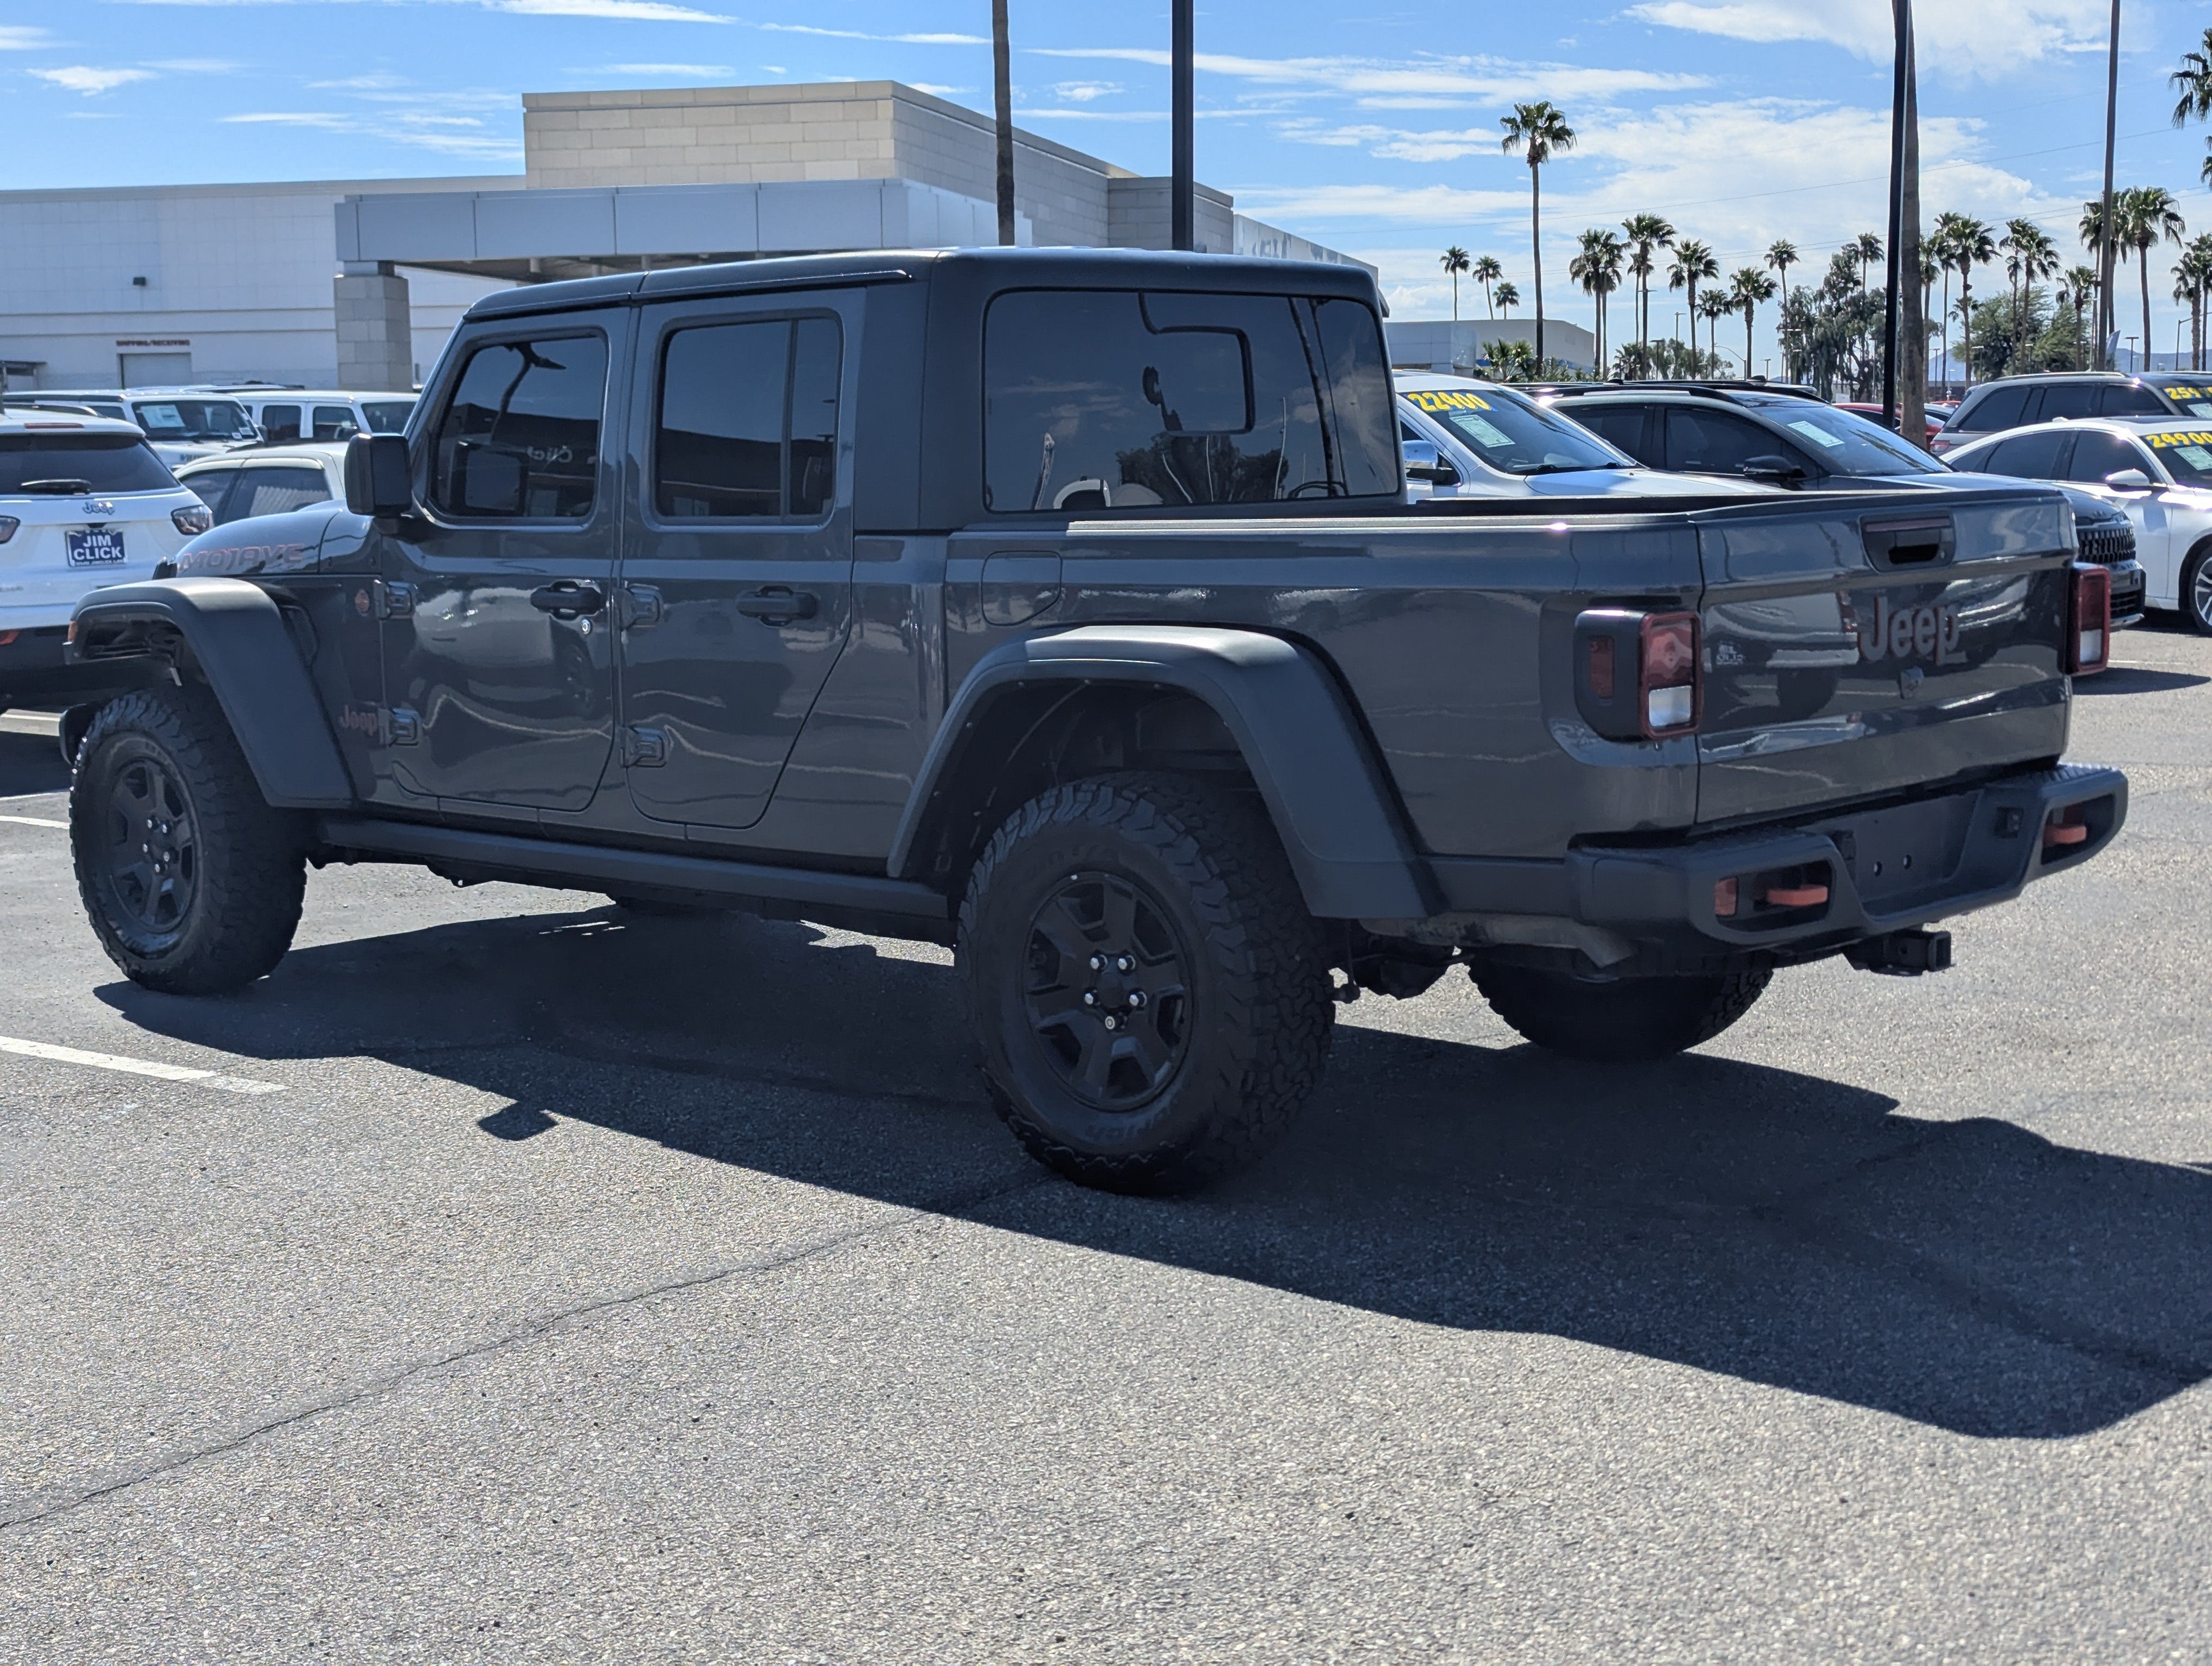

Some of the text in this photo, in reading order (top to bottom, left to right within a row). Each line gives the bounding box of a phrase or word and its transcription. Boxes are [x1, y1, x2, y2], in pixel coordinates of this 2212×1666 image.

[1407, 392, 1492, 411] 22400
[82, 501, 115, 515] Jeep
[82, 535, 112, 547] JIM
[73, 546, 122, 560] CLICK
[177, 543, 305, 572] MOJAVE
[1857, 596, 1960, 667] Jeep
[338, 704, 378, 736] Jeep
